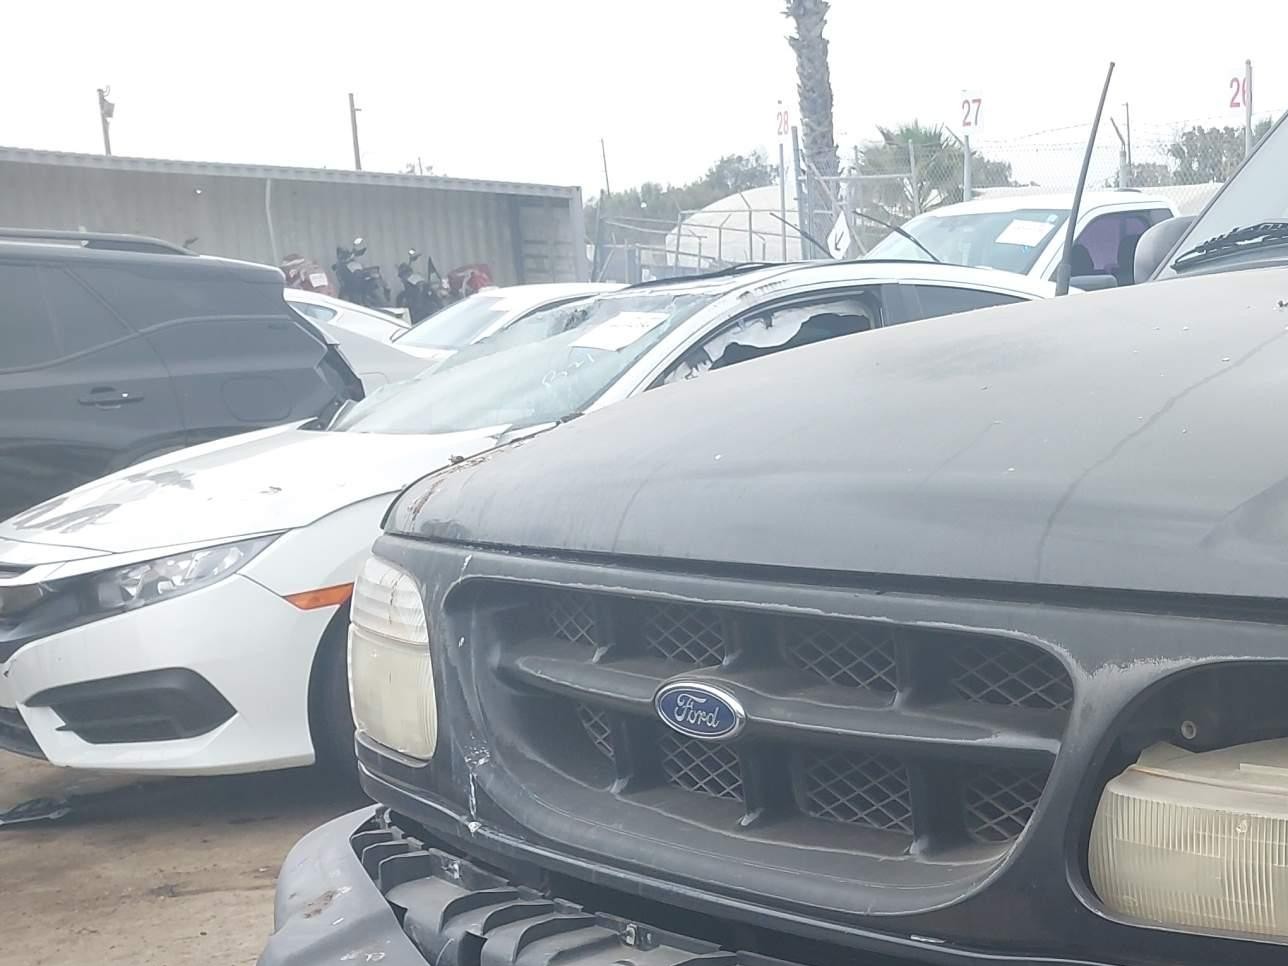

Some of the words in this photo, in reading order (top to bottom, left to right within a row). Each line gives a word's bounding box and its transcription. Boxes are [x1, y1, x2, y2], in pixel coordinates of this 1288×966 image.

[776, 110, 789, 135] 28
[962, 98, 982, 127] 27
[673, 694, 720, 728] Ford
